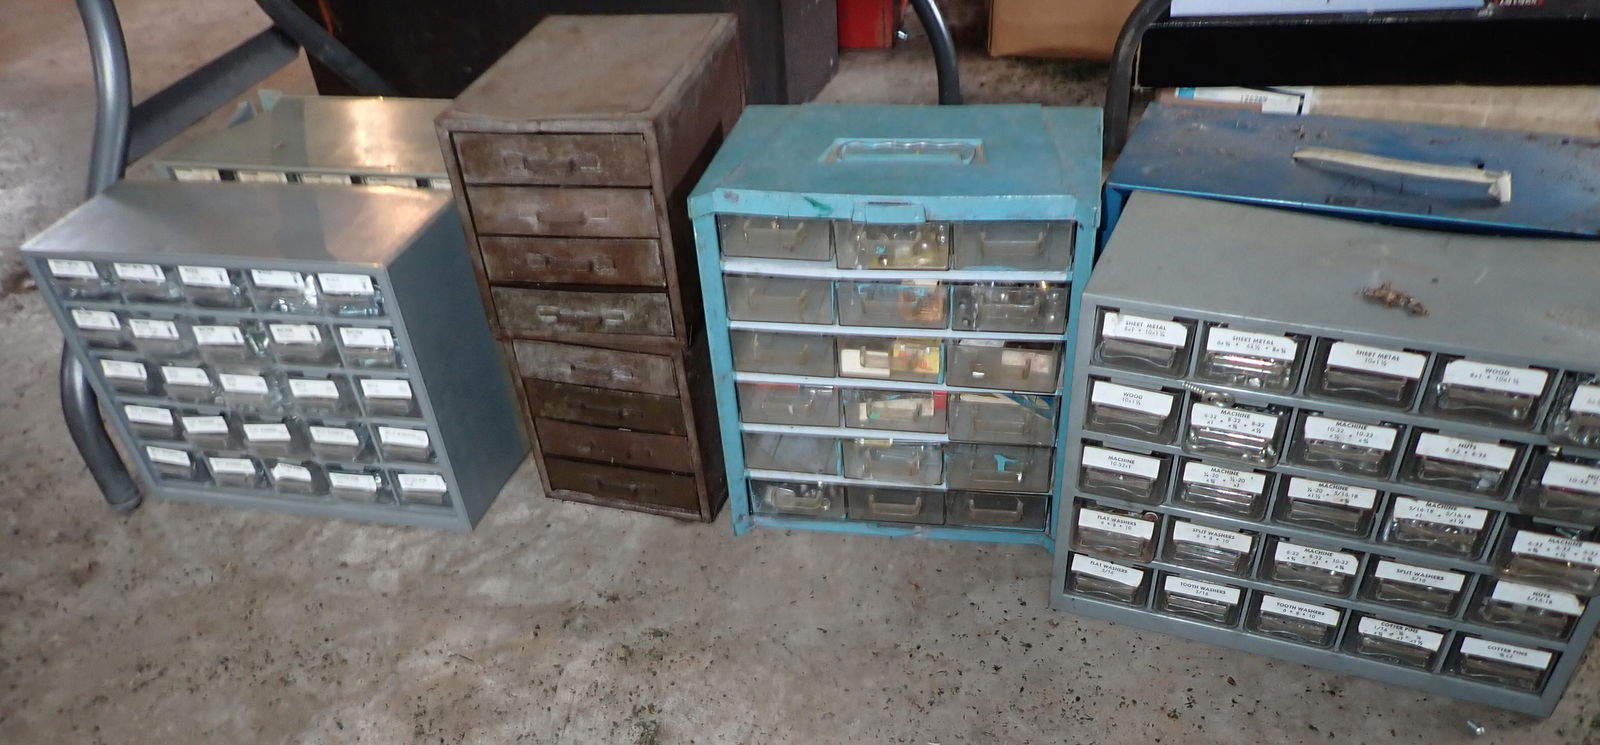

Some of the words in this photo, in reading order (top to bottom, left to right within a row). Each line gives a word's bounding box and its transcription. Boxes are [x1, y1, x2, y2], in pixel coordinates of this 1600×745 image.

[1378, 353, 1400, 361] METAL
[1221, 410, 1250, 419] MACHINE
[1336, 421, 1367, 430] MACHINE
[1108, 456, 1135, 464] MACHINE
[1211, 468, 1239, 476] MACHINE
[1319, 483, 1348, 491] MACHINE
[1426, 501, 1457, 510] MACHINE
[1111, 518, 1136, 526] WASHERS
[1208, 531, 1235, 539] WASHERS
[1304, 548, 1333, 556] MACHINE
[1104, 565, 1128, 573] WASHERS
[1414, 572, 1444, 580] WASHERS
[1200, 586, 1226, 594] WASHERS
[1277, 602, 1296, 610] TOOTH
[1298, 607, 1325, 615] WASHERS
[1381, 622, 1403, 630] COTTER
[1487, 645, 1511, 653] COTTER
